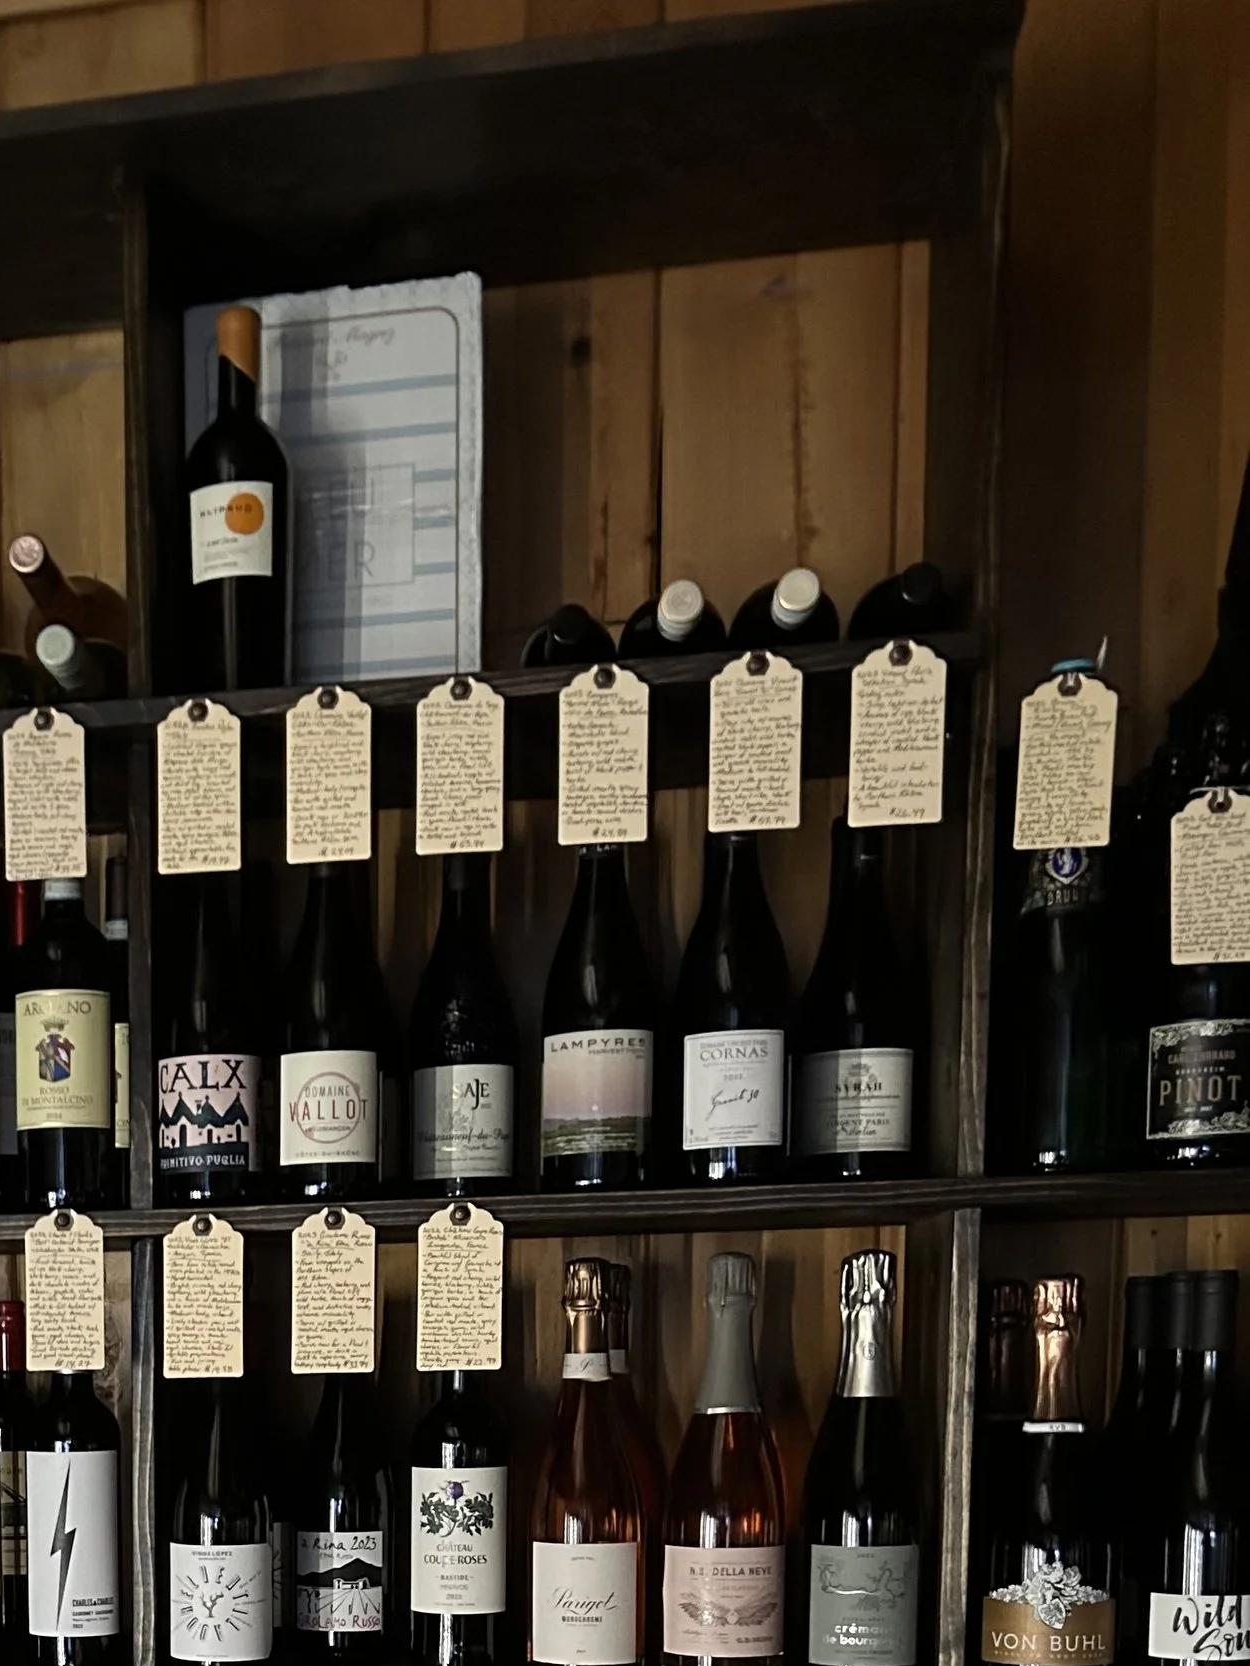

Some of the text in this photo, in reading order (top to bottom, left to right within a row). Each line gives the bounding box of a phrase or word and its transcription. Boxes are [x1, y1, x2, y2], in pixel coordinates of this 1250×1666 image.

[24, 1000, 92, 1016] ARNO
[551, 1036, 646, 1052] LAMPYRES
[700, 1046, 768, 1061] CORNAS
[160, 1060, 246, 1093] CALX
[305, 1085, 351, 1097] DOMAINE
[1158, 1074, 1242, 1106] PINOT
[289, 1099, 369, 1123] VALLOT
[206, 1153, 245, 1166] PUGLIA
[313, 1536, 377, 1551] Rina 2023
[712, 1566, 746, 1577] DELLA
[352, 1614, 381, 1629] RUSSO
[1173, 1595, 1242, 1636] Wild
[991, 1631, 1106, 1651] VON BUHL
